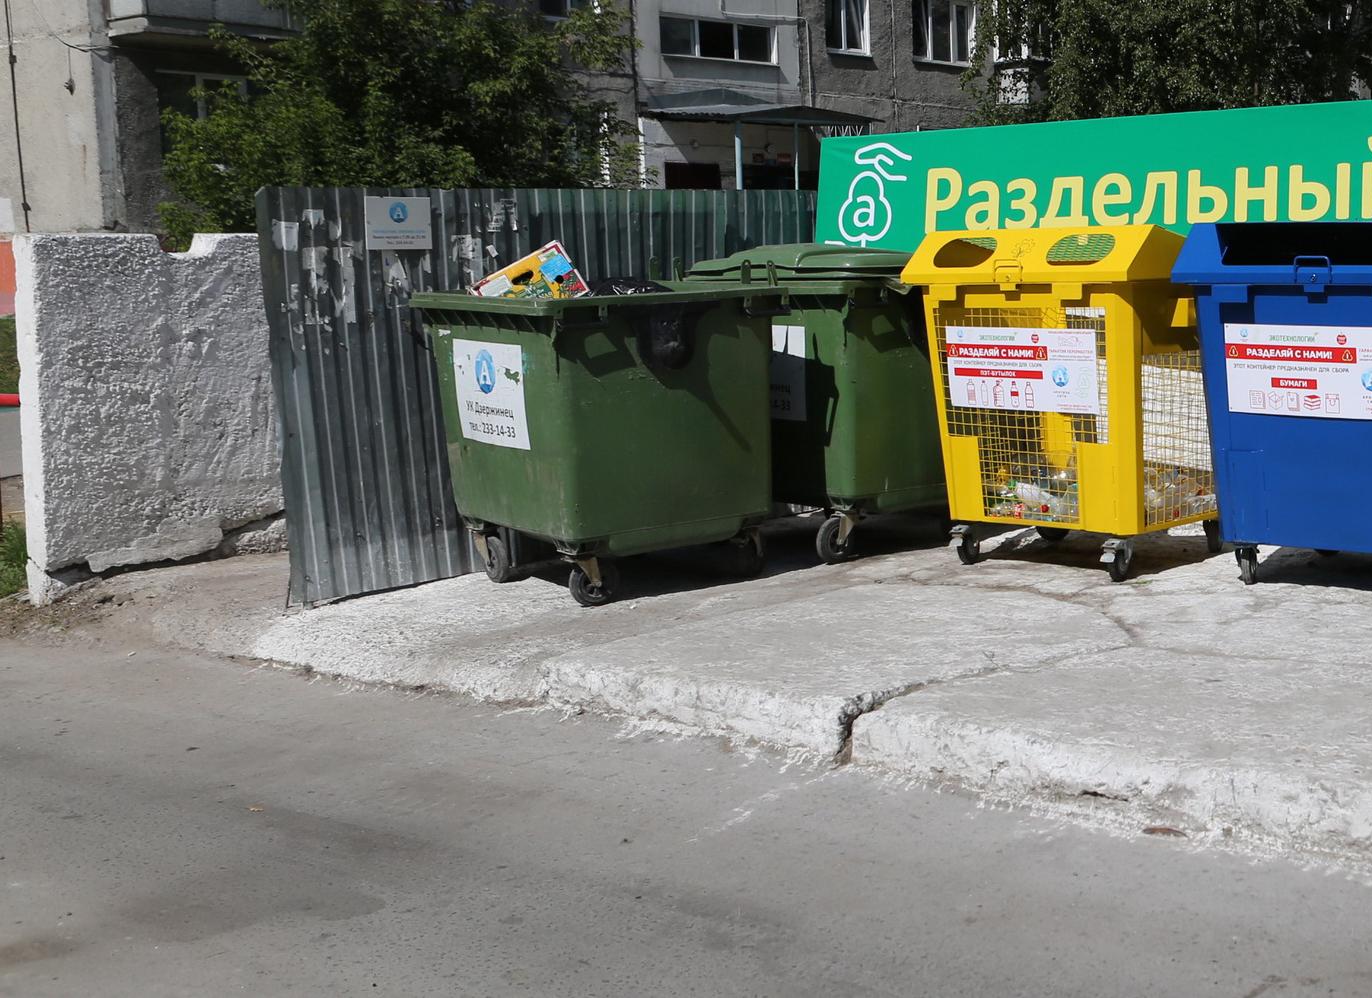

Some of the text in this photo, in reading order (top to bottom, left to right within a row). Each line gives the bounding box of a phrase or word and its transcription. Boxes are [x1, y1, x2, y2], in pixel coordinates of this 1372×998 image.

[1269, 334, 1315, 343] ЭКОТЕХНОЛОГИИ
[959, 346, 1034, 358] РАЗДЕЛЯЙ С НАМИ!
[1246, 347, 1333, 359] РАЗДЕЛЯЙ С НАМИ!
[1280, 379, 1308, 387] БУМАГИ
[465, 400, 514, 420] УК Дзержинец
[469, 421, 516, 438] тел.: 233-14-33
